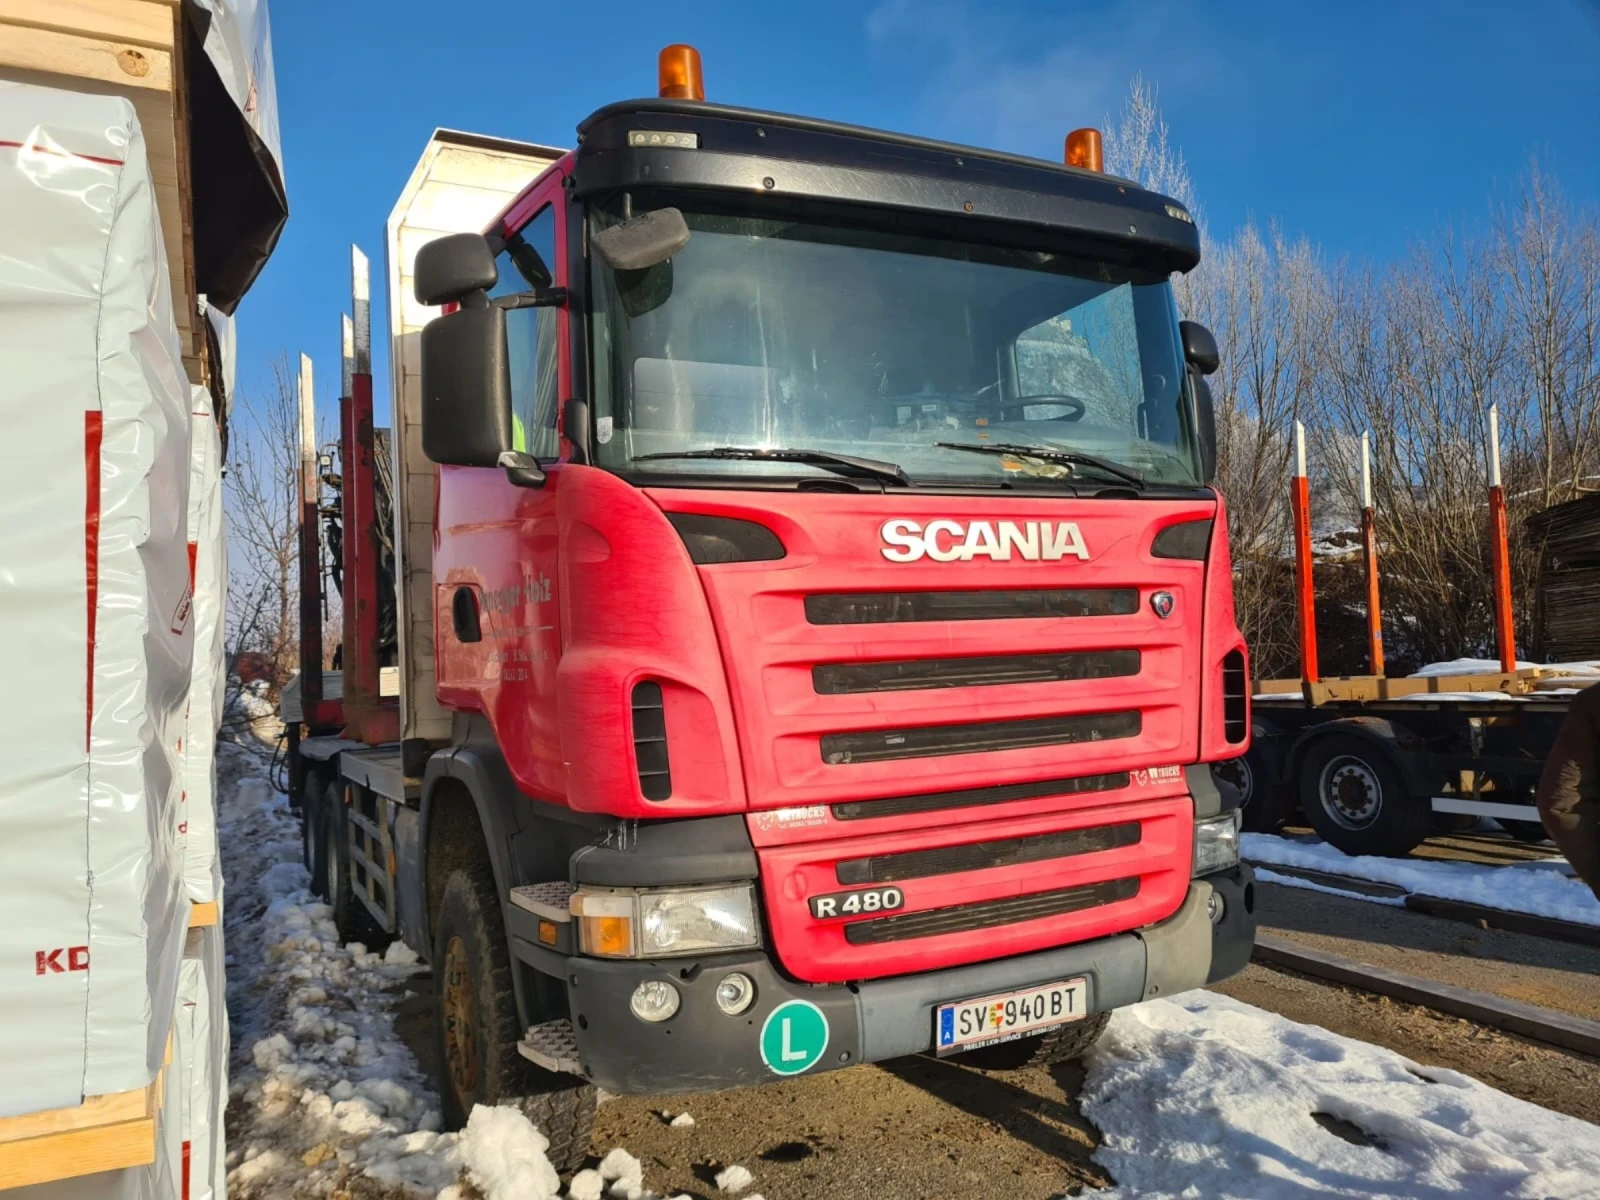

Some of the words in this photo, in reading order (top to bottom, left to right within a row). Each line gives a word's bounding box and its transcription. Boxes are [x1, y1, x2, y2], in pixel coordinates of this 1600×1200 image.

[880, 519, 1091, 563] SCANIA
[817, 898, 837, 919] R
[842, 889, 901, 914] 480
[35, 946, 89, 976] KD
[959, 1005, 987, 1036] SV
[1005, 994, 1045, 1026] 940
[1051, 987, 1076, 1017] BT
[781, 1018, 807, 1062] L
[943, 1031, 951, 1041] A
